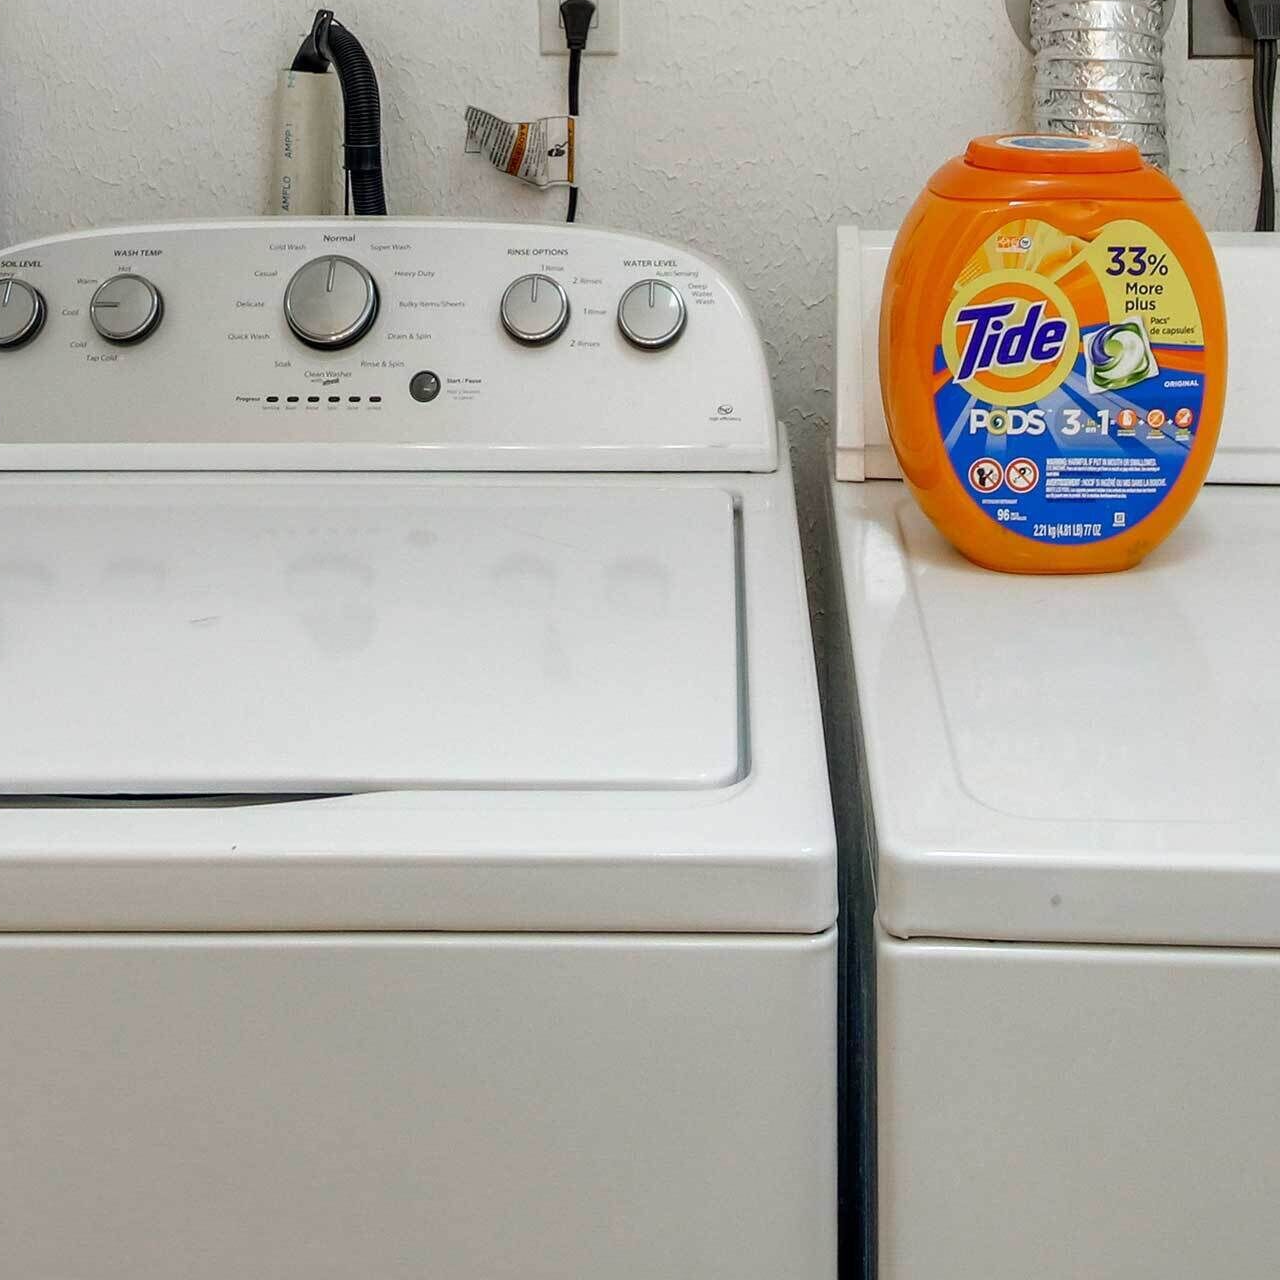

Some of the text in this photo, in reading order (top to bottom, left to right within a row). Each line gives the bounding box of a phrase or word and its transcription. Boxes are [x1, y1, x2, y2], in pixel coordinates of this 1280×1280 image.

[323, 234, 356, 242] Normal
[1106, 247, 1168, 276] 33%
[1126, 282, 1163, 295] More
[1125, 297, 1156, 313] plus
[956, 302, 1068, 381] Tide
[1164, 380, 1199, 388] ORIGINAL
[969, 409, 1046, 436] PODS
[1061, 409, 1081, 436] 3
[1097, 409, 1110, 436] 1
[997, 509, 1010, 521] 96
[1033, 524, 1047, 536] 2.21
[1048, 524, 1056, 538] kg
[1083, 524, 1092, 536] 77
[1092, 524, 1102, 536] OZ
